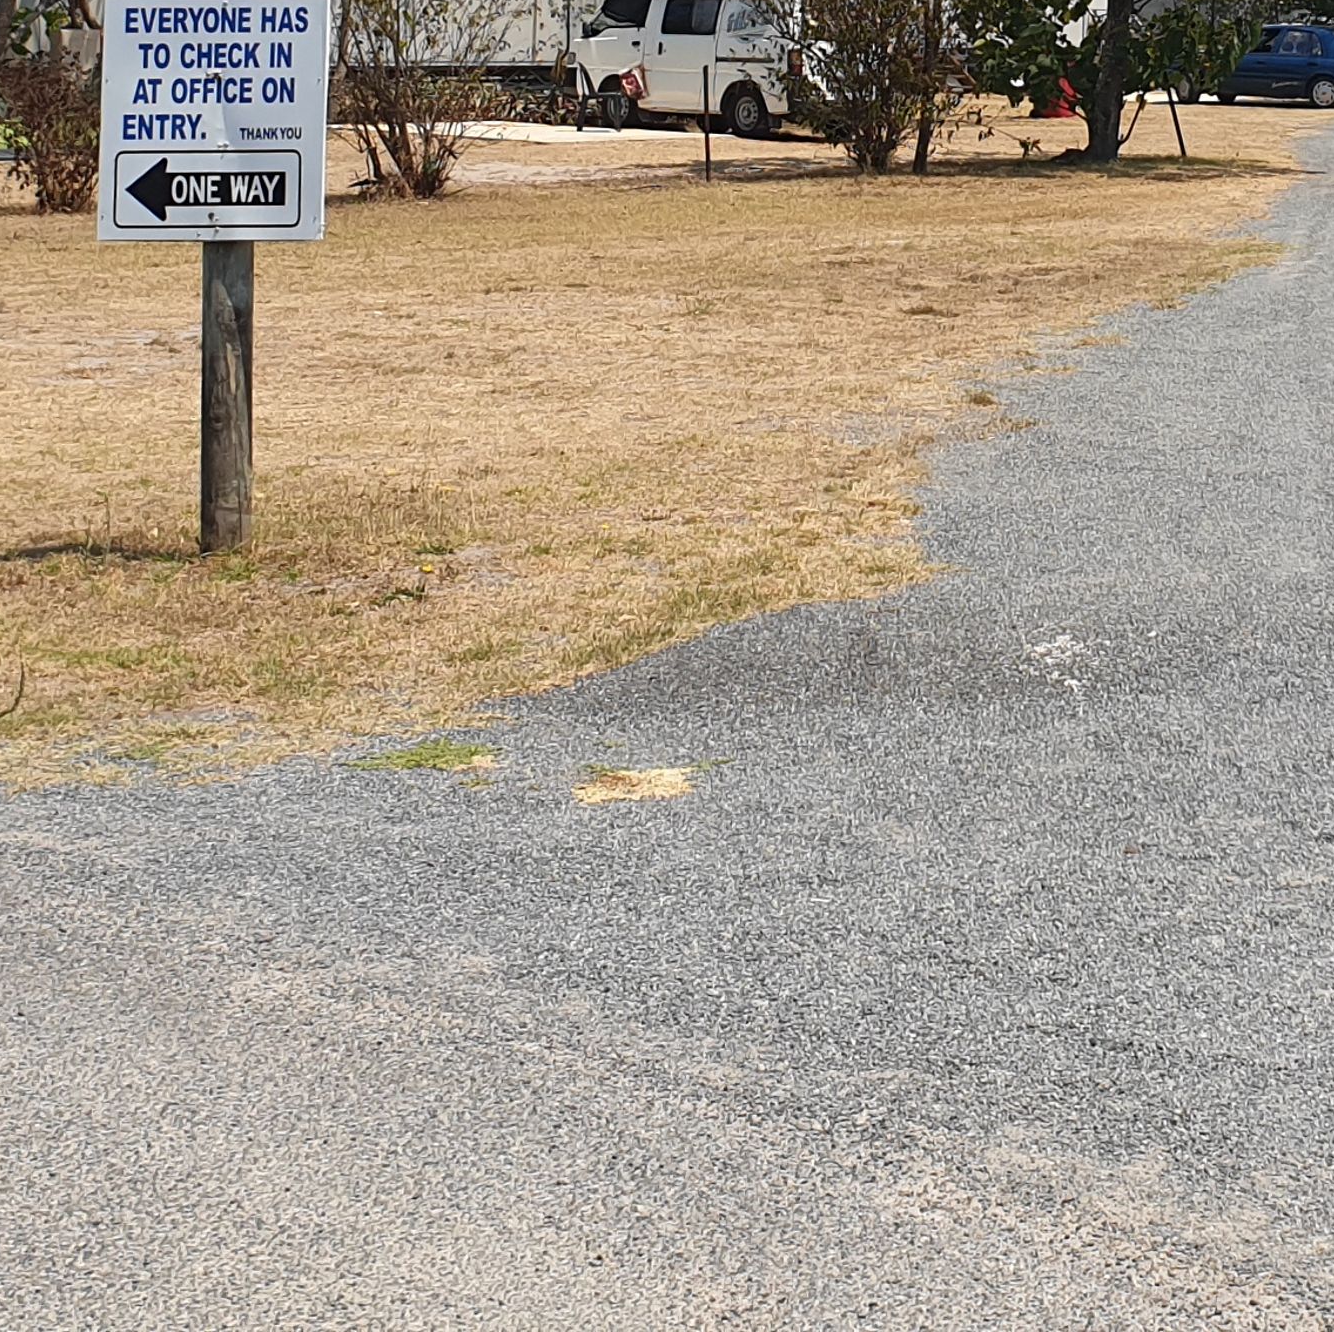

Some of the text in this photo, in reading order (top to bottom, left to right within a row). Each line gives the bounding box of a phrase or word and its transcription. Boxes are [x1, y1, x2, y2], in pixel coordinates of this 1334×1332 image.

[125, 6, 309, 34] EVERYONE HAS
[138, 42, 293, 69] TO CHECK IN
[132, 77, 295, 104] AT OFFICE ON
[122, 114, 207, 140] ENTRY.
[239, 127, 302, 140] THANK YOU
[171, 174, 281, 204] ONE WAY
